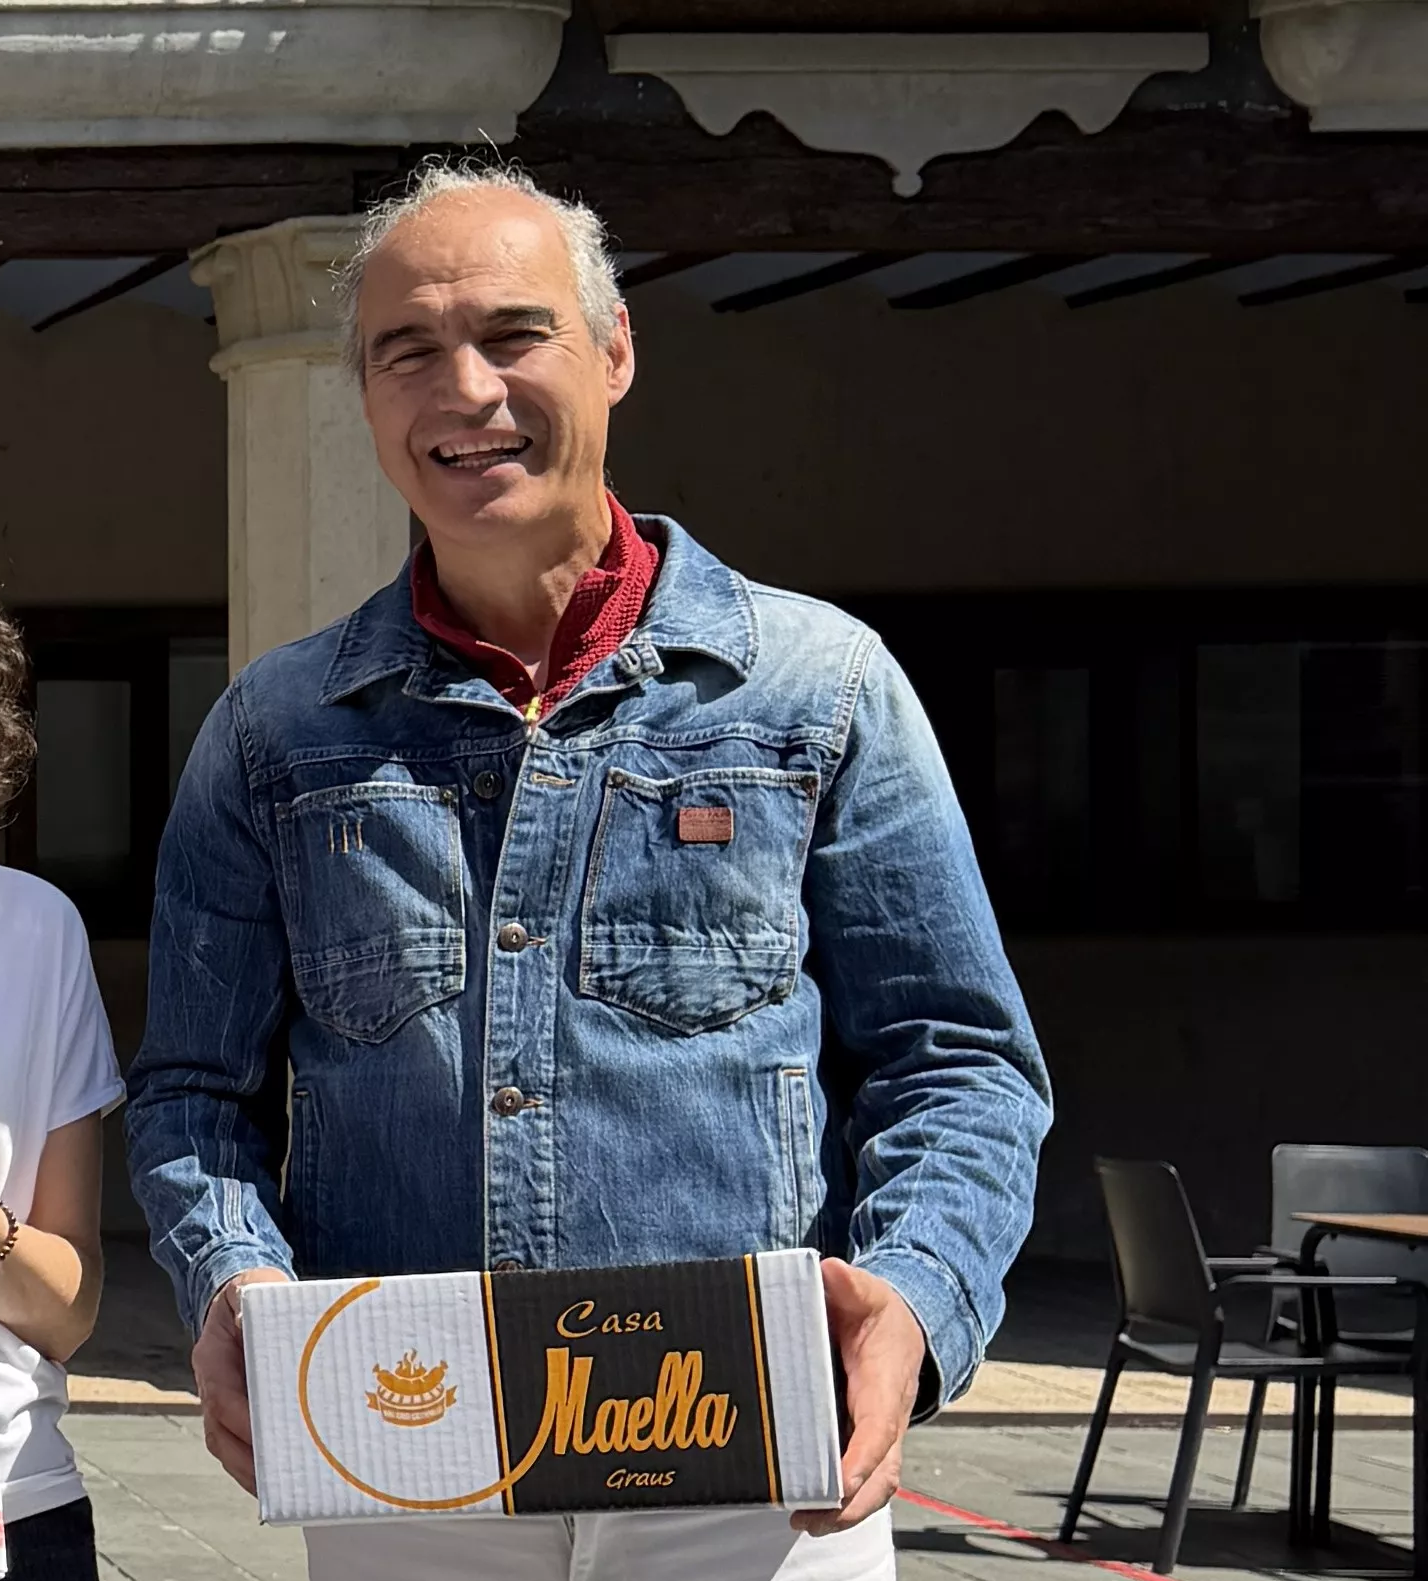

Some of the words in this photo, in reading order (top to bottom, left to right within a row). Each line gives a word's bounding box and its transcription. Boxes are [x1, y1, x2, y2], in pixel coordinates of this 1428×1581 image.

[556, 1300, 664, 1339] Casa
[536, 1346, 739, 1455] Maella
[605, 1468, 676, 1489] Graus
